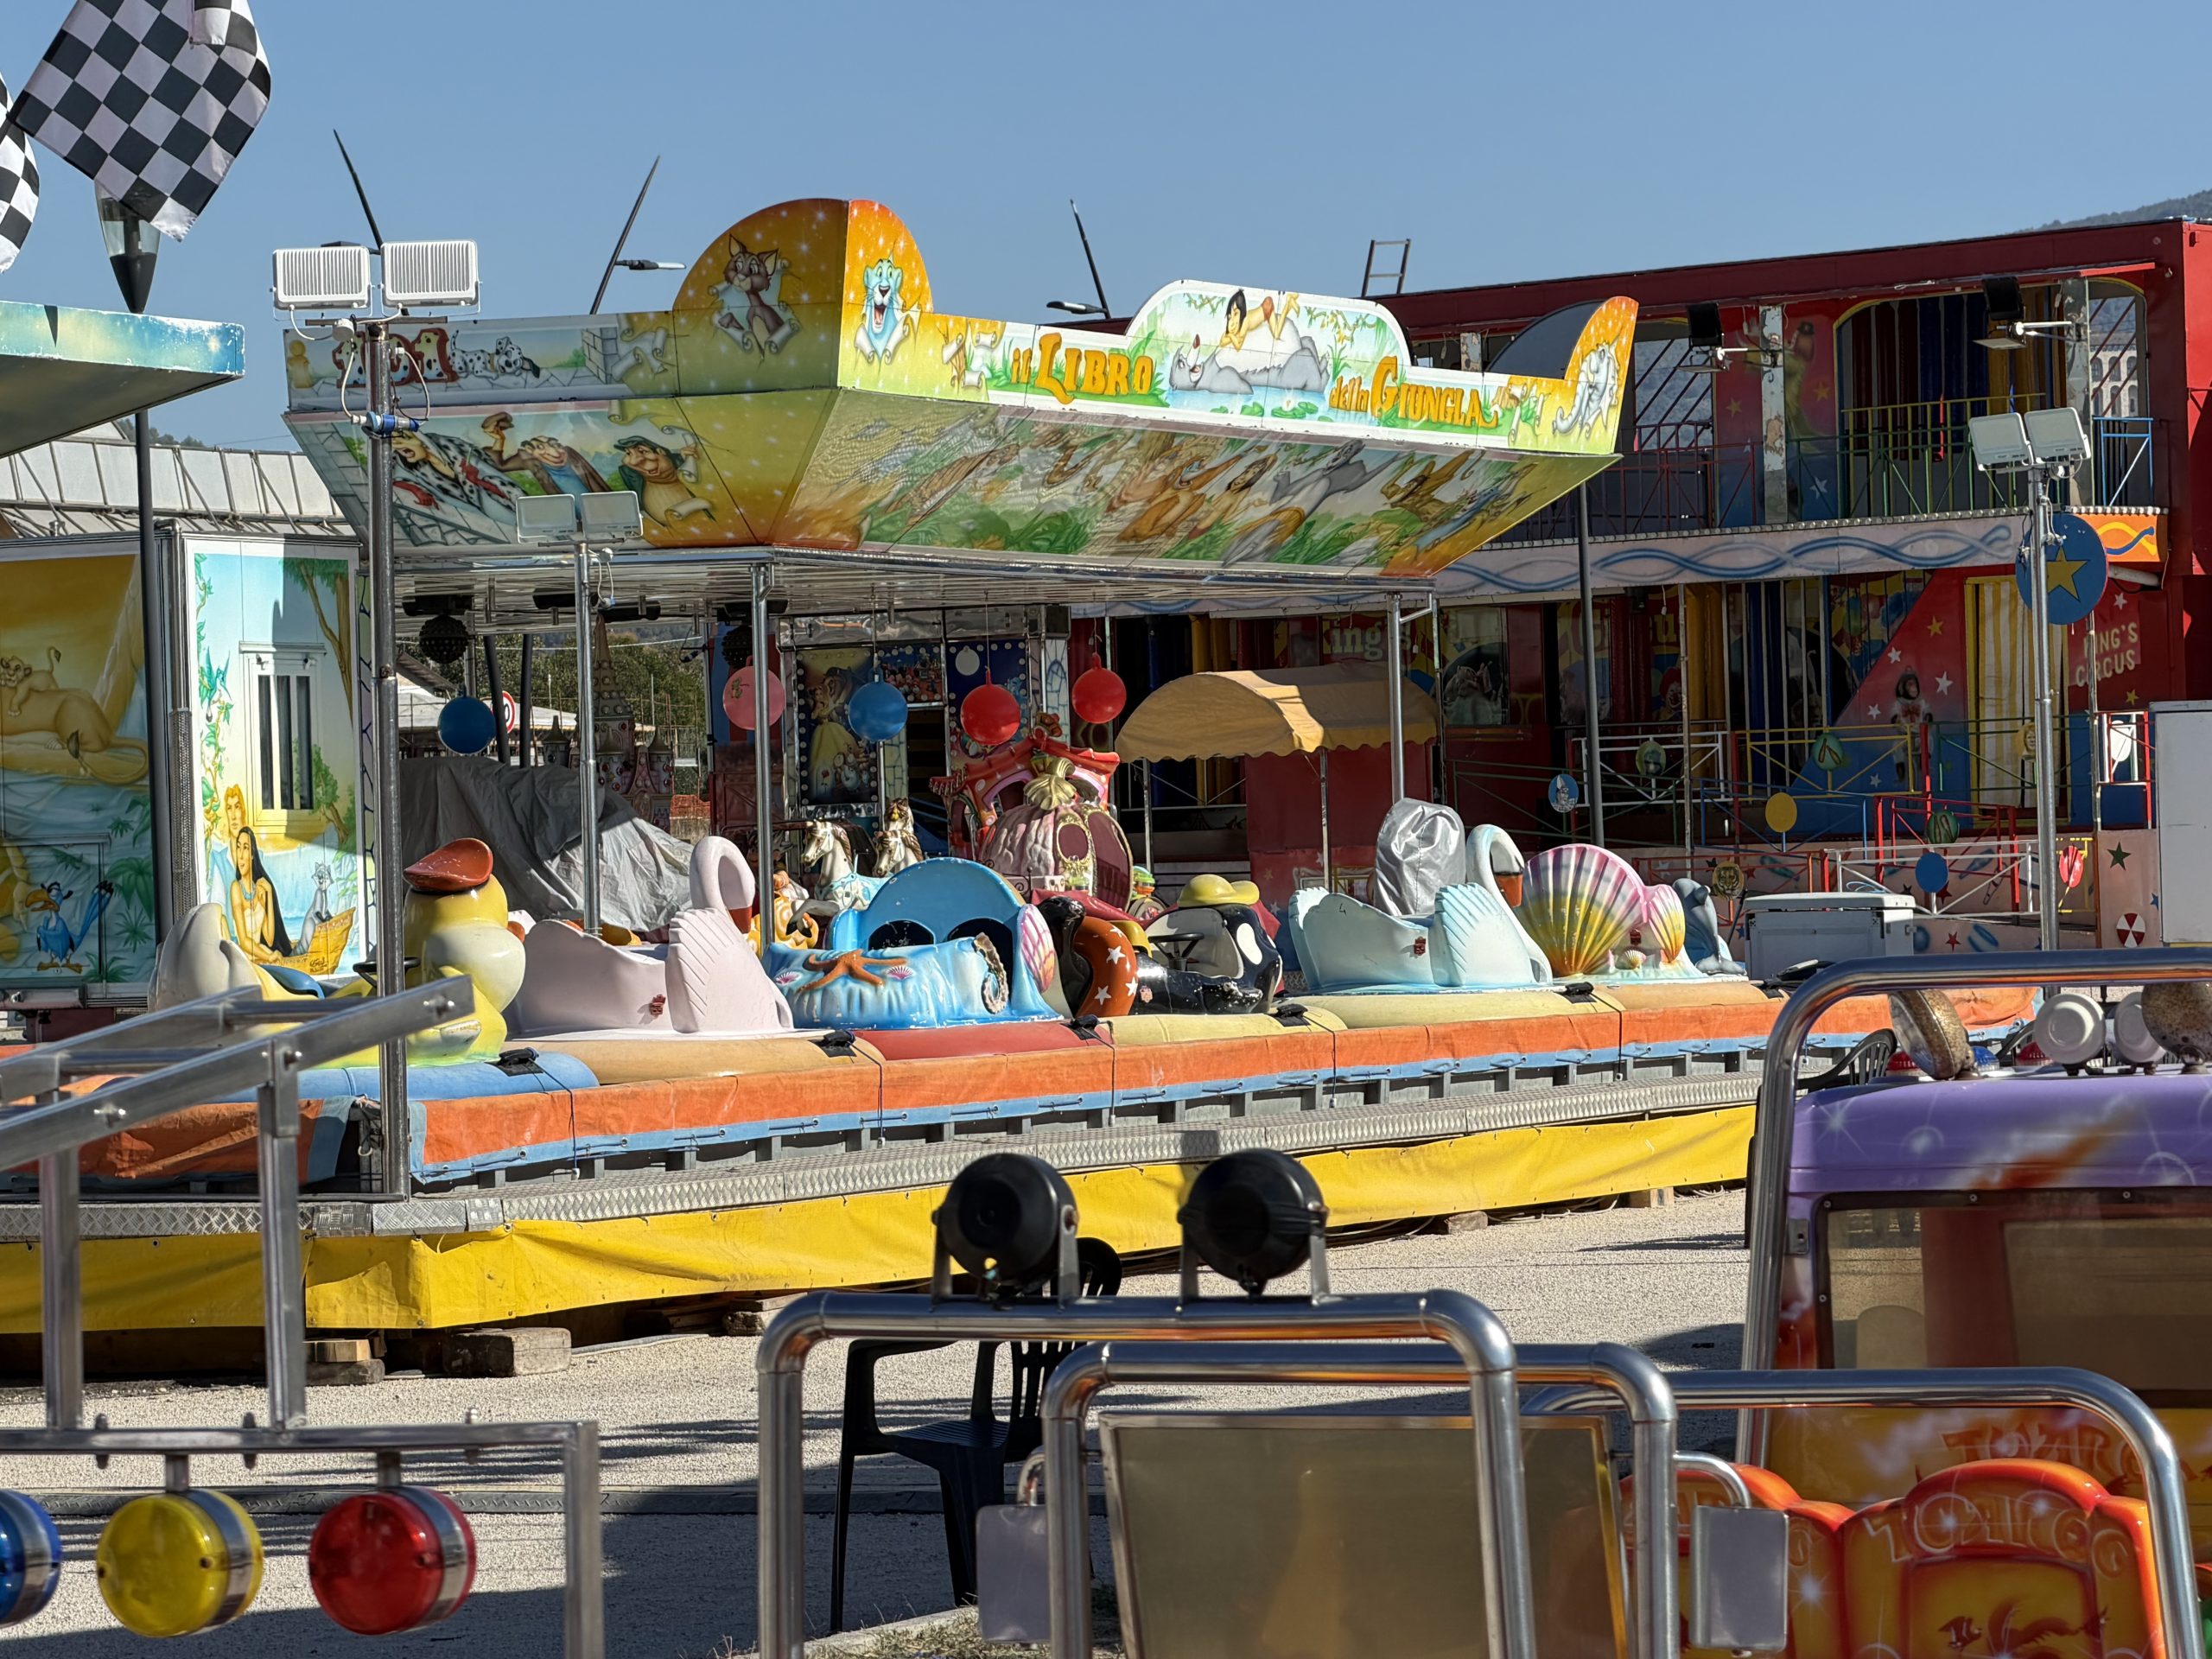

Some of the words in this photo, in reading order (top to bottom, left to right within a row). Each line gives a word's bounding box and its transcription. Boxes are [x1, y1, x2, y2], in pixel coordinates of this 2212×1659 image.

[1011, 347, 1032, 384] il
[1035, 332, 1154, 405] LIBRO
[1370, 355, 1499, 429] GIUNGLA
[2075, 649, 2135, 688] CRCUS
